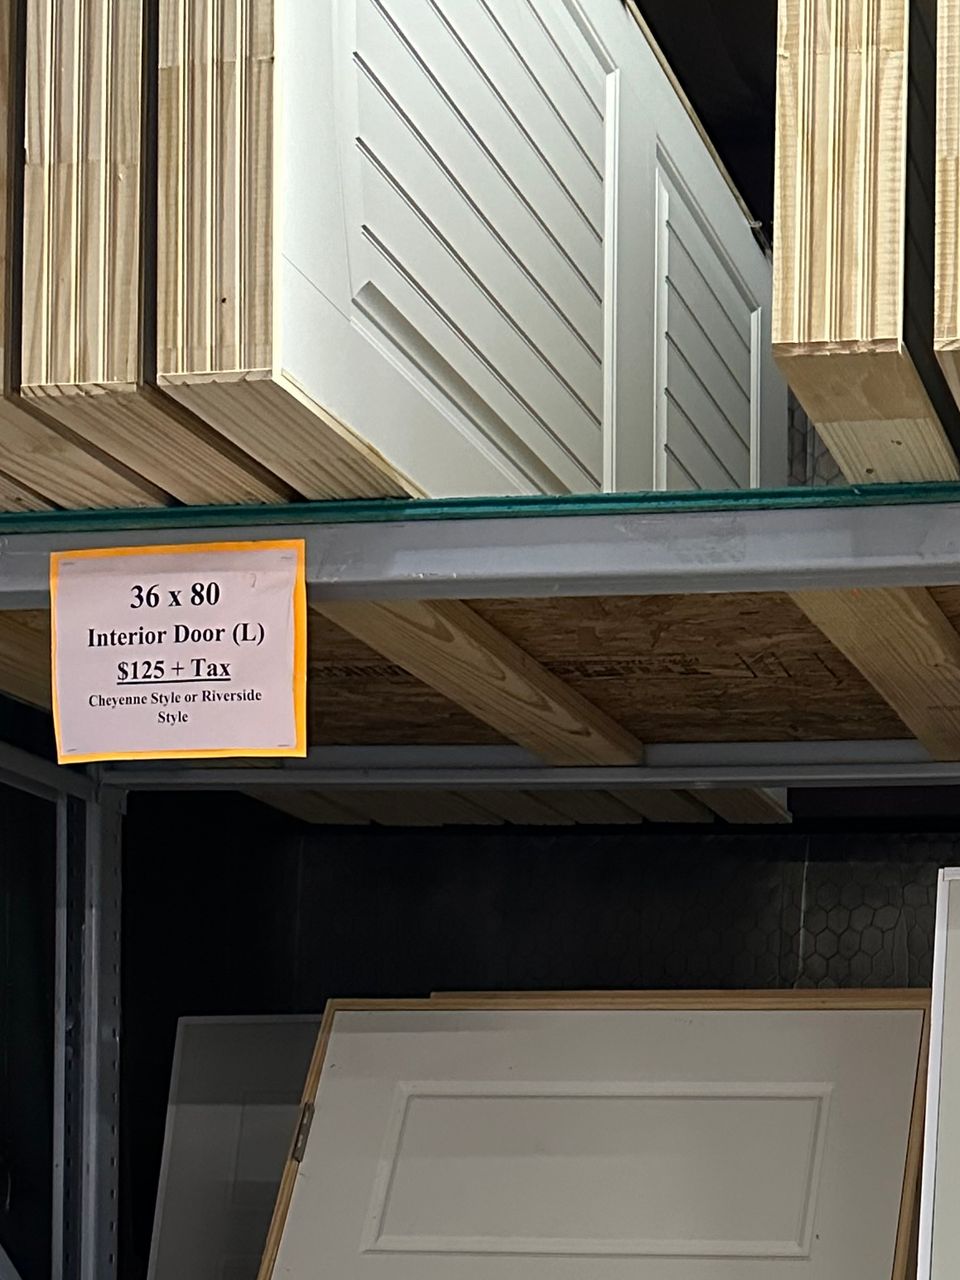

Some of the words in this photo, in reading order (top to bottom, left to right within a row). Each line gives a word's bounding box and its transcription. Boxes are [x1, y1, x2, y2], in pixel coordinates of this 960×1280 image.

[130, 584, 160, 609] 36
[168, 591, 182, 606] x
[191, 582, 219, 606] 80
[88, 626, 166, 647] Interior
[174, 624, 225, 643] Door
[233, 623, 264, 646] (L)
[117, 660, 164, 681] $125
[172, 662, 184, 676] +
[191, 658, 231, 677] Tax
[89, 694, 147, 708] Cheyenne
[151, 692, 180, 706] Style
[184, 693, 197, 702] or
[202, 689, 262, 702] Riverside
[158, 711, 188, 726] Style
